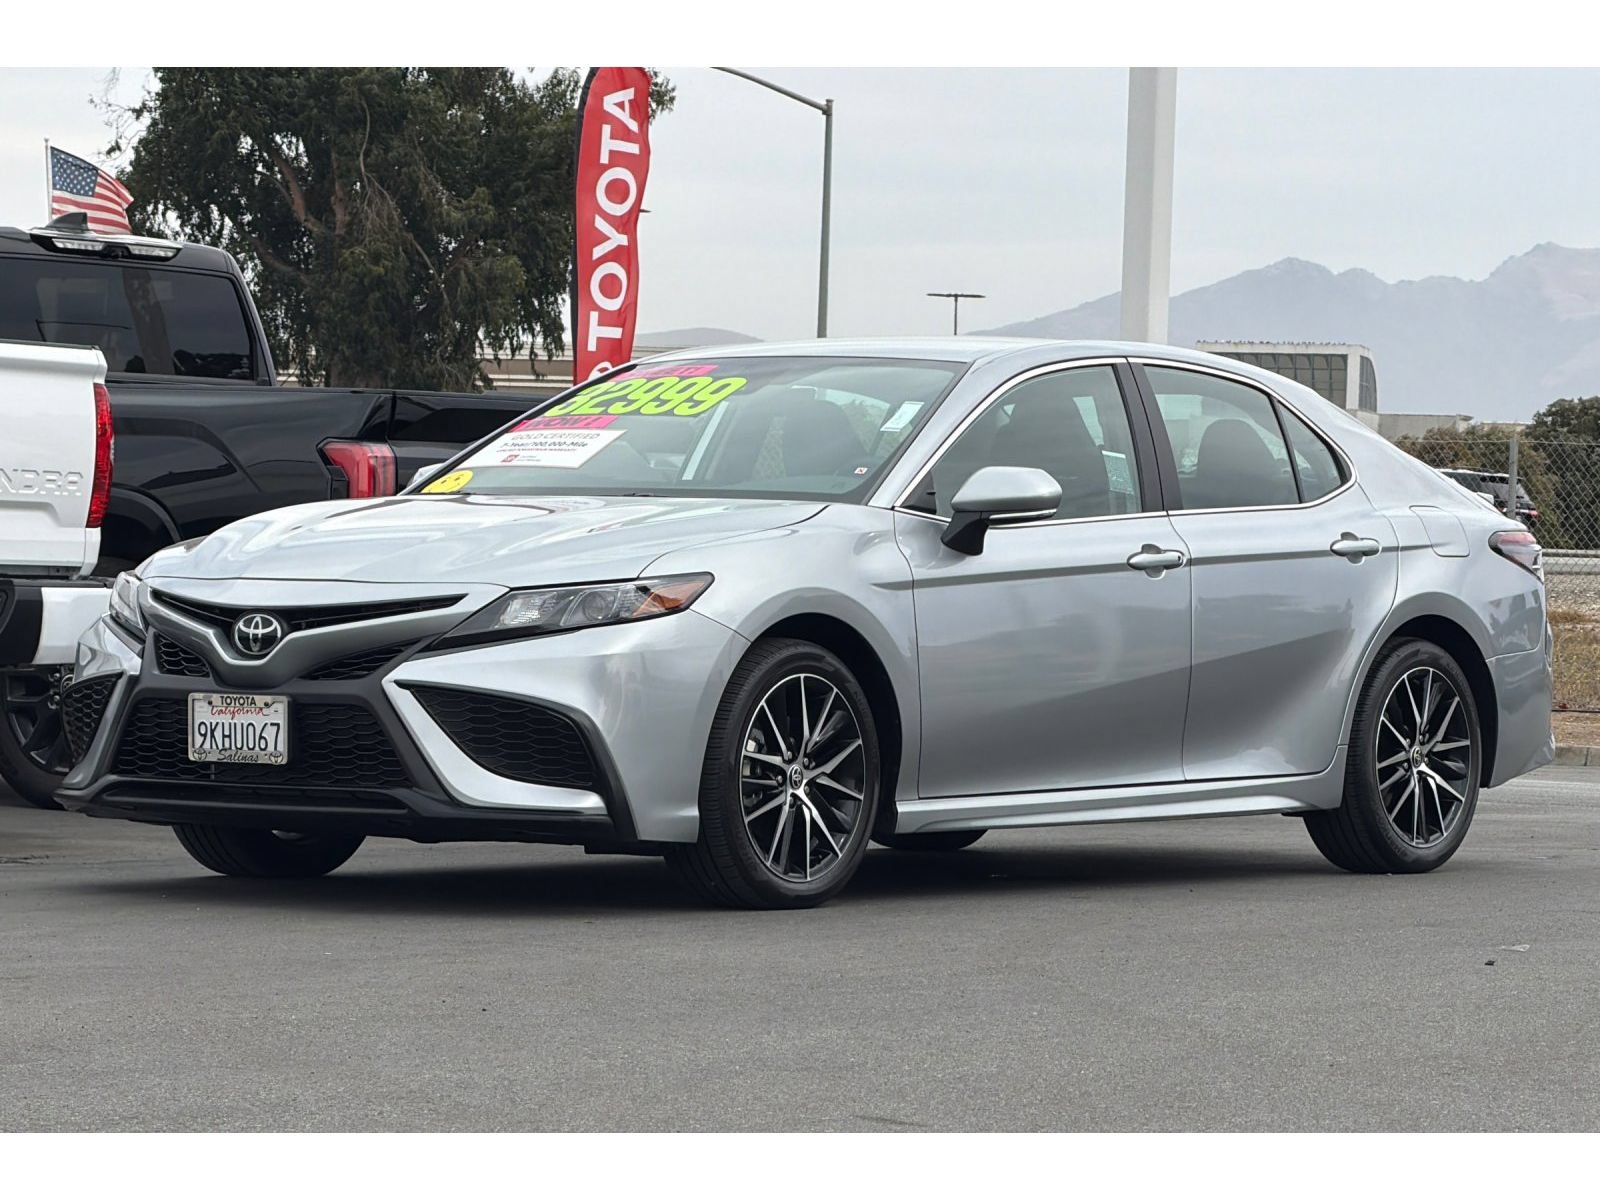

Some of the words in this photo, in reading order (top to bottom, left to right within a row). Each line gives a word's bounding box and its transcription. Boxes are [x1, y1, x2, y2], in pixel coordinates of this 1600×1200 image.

[587, 86, 640, 352] TOYOTA
[543, 378, 748, 416] 32999
[511, 433, 543, 441] GOLD
[220, 695, 257, 707] TOYOTA
[211, 705, 269, 720] California
[197, 721, 281, 752] 9KHU067
[217, 748, 259, 762] Salinas
